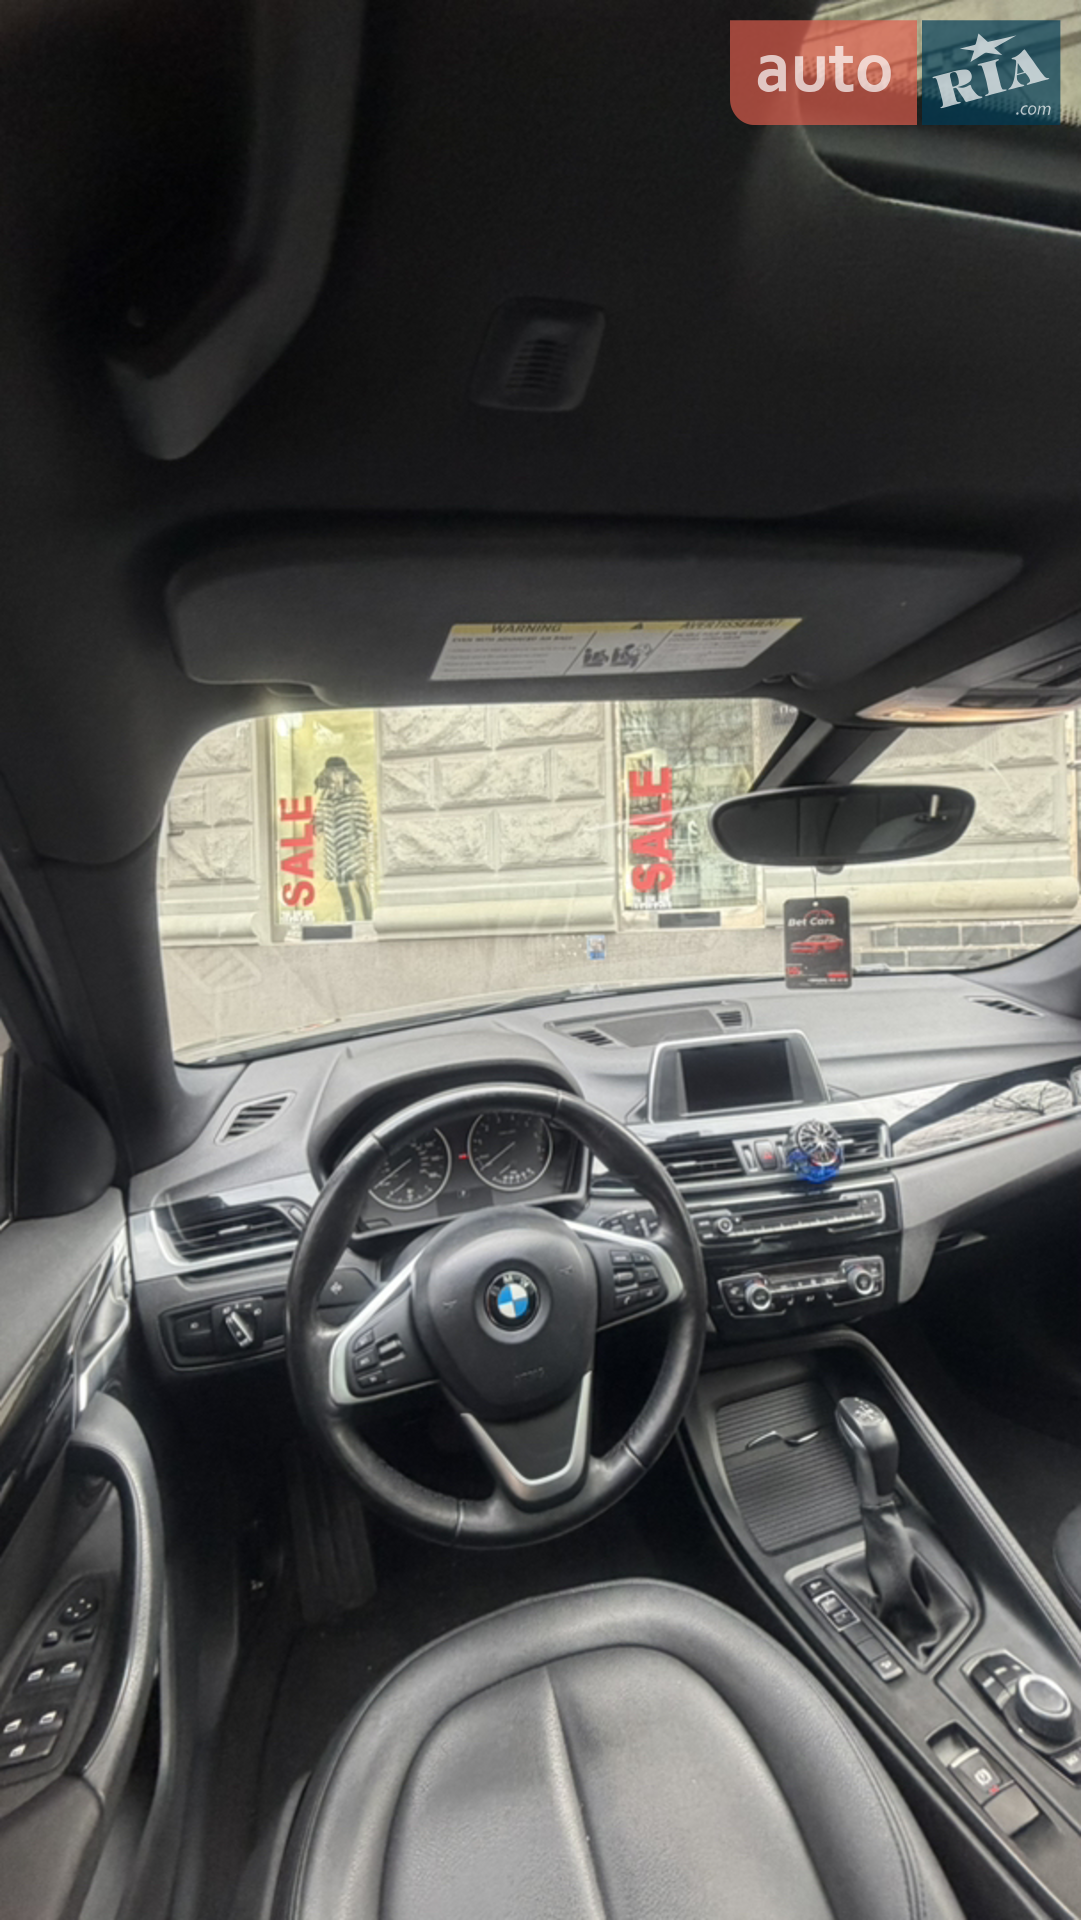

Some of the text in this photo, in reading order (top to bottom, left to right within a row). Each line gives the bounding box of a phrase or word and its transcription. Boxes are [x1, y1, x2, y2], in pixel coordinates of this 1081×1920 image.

[491, 624, 562, 634] WARNING
[681, 618, 784, 630] AVERTISSEMENT
[628, 767, 676, 893] SALE
[279, 796, 315, 907] SALE
[809, 917, 836, 926] Cars
